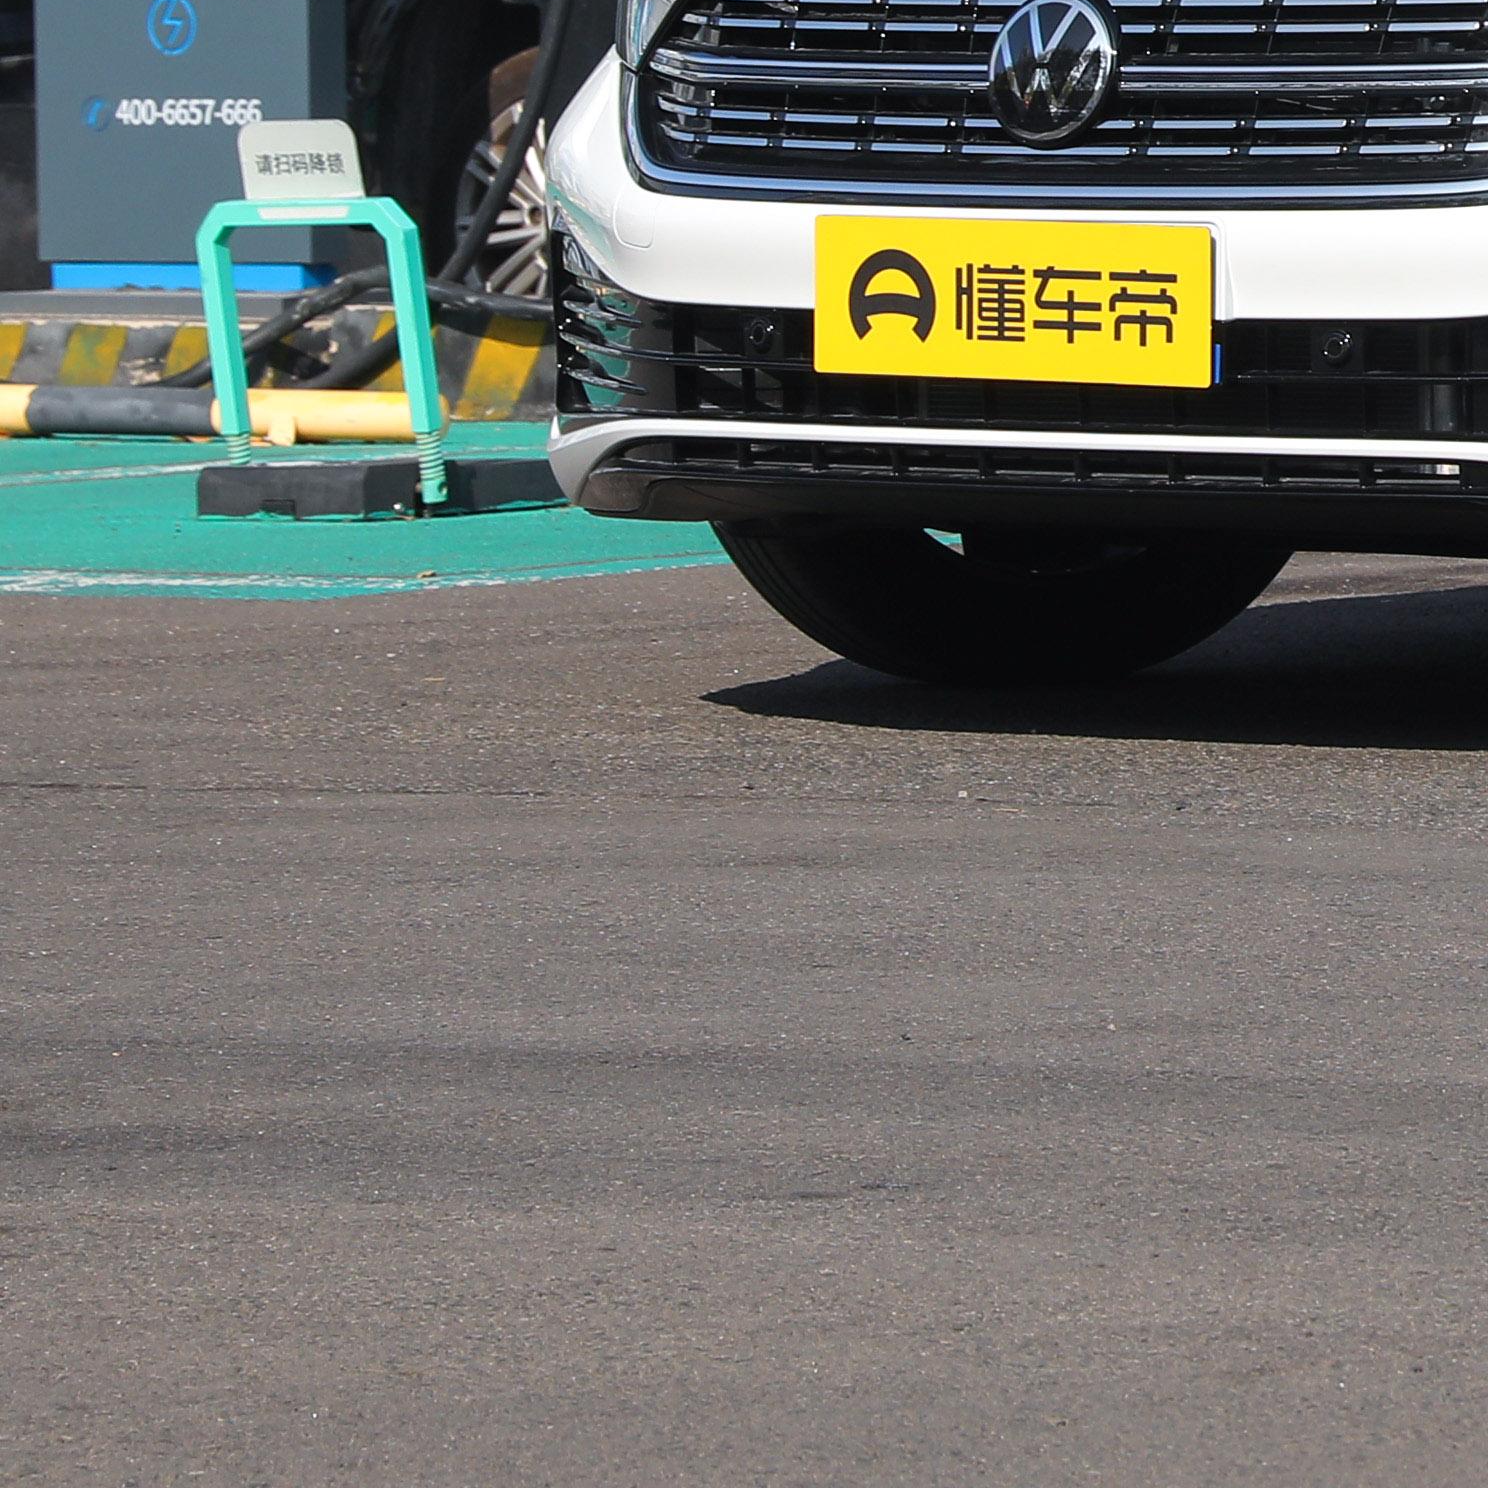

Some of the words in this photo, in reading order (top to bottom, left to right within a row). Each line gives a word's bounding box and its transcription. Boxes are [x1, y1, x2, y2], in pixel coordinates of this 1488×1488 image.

[115, 98, 263, 126] 400-6657-666
[955, 263, 1178, 347] 懂车帝
